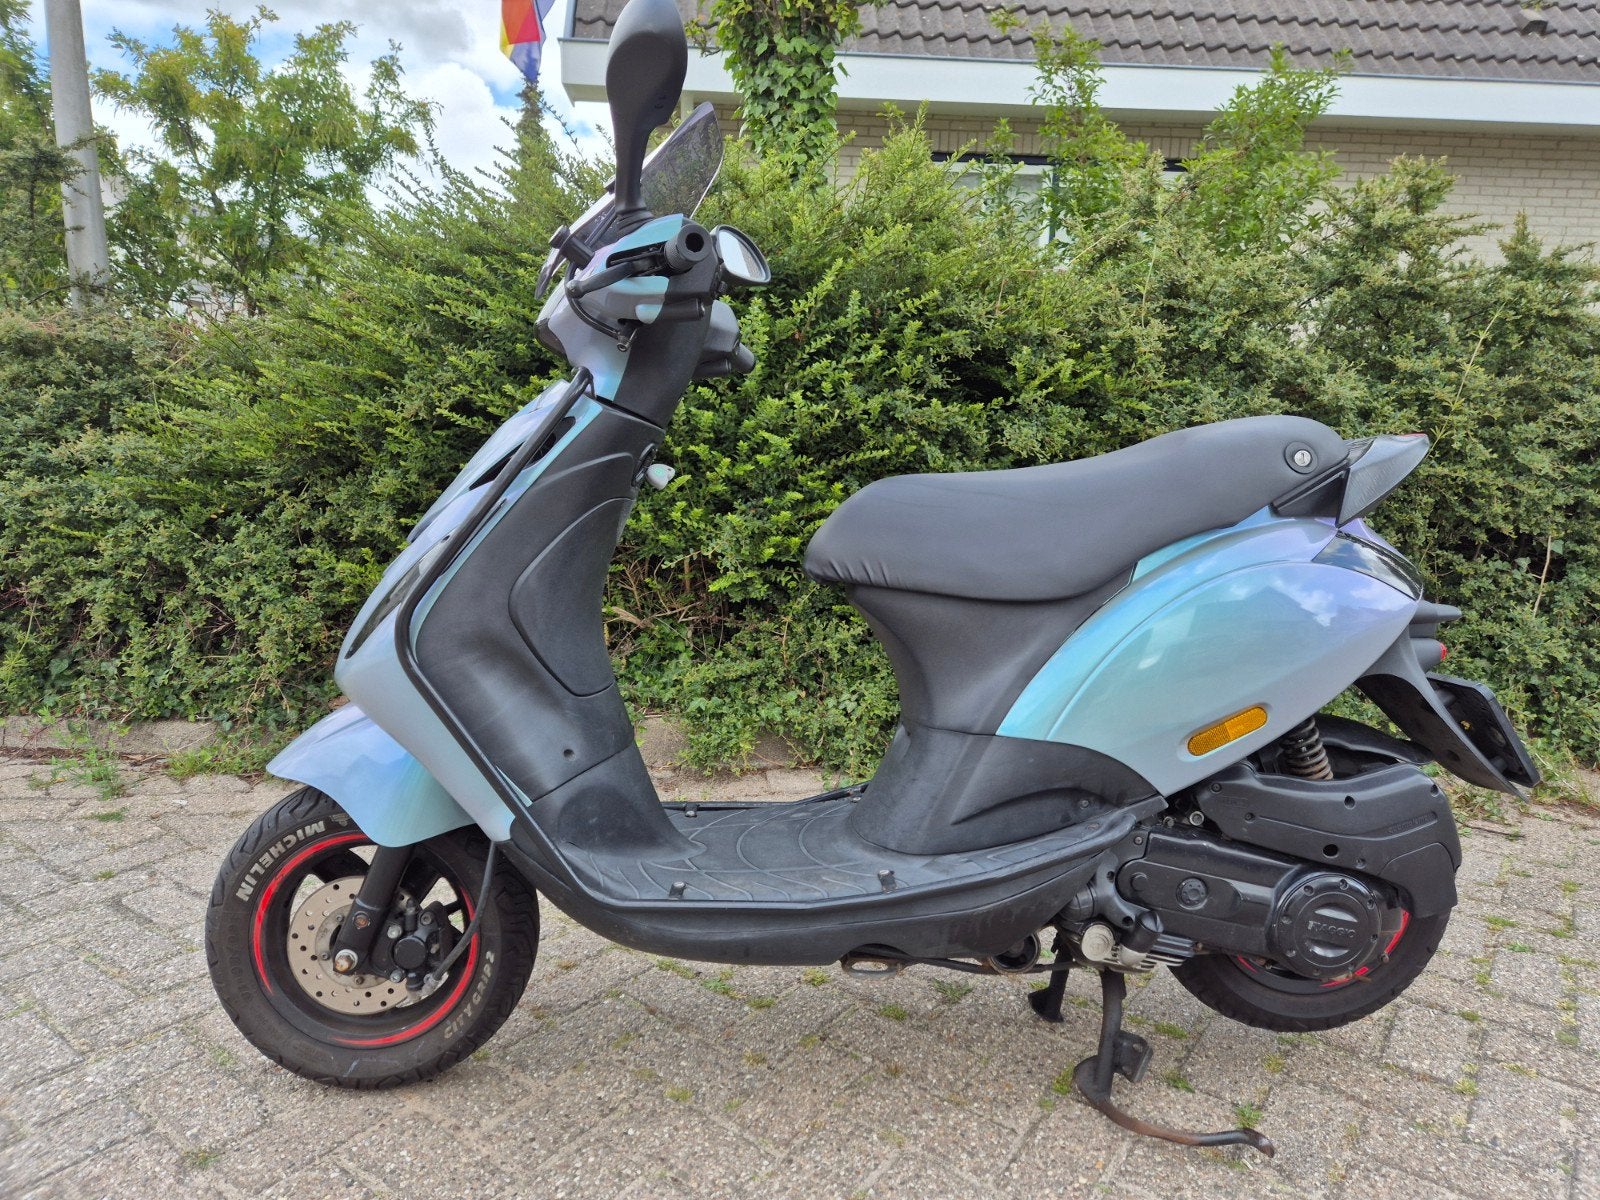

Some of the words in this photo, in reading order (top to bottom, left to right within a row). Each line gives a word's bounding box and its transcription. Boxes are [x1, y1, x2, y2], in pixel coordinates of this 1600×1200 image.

[235, 820, 326, 902] MICHELIN
[1307, 919, 1357, 938] PIAGGIO
[444, 1002, 473, 1039] CITY
[472, 963, 491, 1005] GRIP
